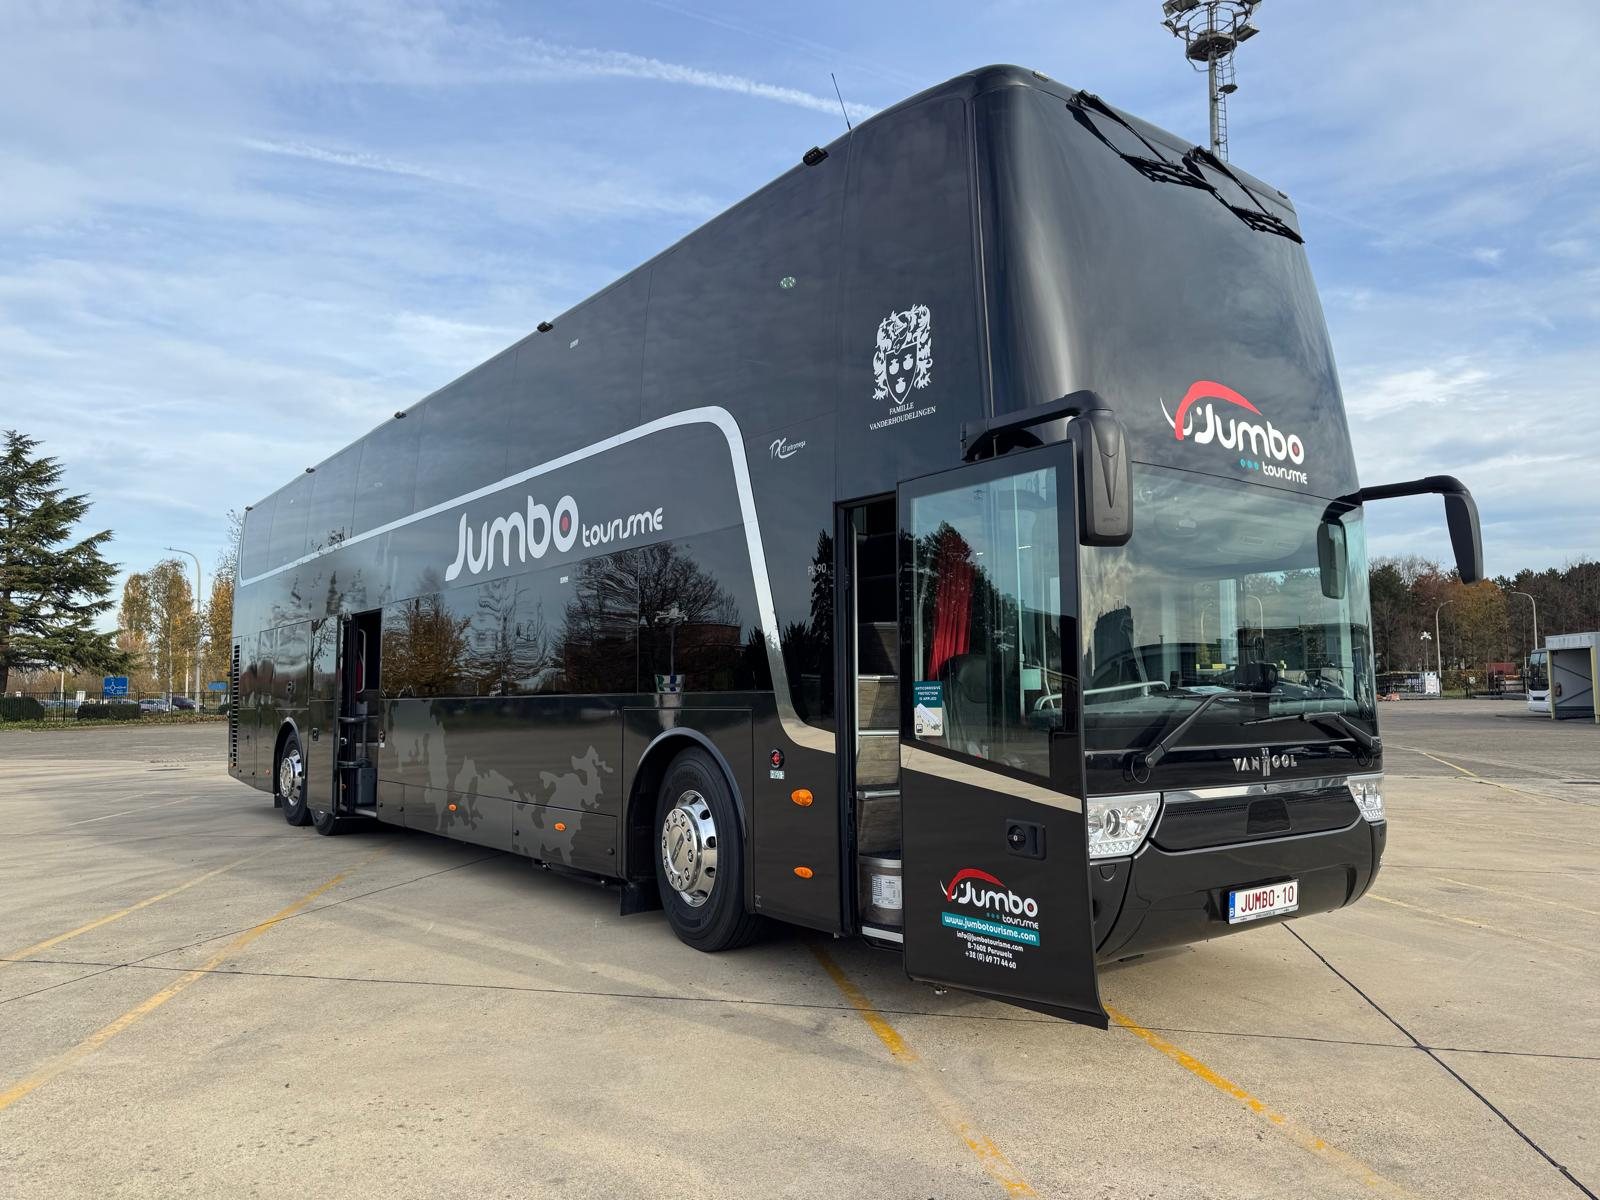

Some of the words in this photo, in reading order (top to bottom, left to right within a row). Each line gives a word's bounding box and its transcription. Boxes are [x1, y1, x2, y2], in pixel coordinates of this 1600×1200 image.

[869, 405, 937, 431] VANDERHOUDELINGEN
[889, 402, 915, 415] FAMILLE
[1194, 402, 1305, 466] Jumbo
[1262, 460, 1309, 486] tourisme
[445, 494, 579, 583] Jumbo
[582, 507, 664, 548] tourisme
[957, 881, 1039, 919] Jumbo
[943, 914, 1037, 942] www.jumbotourisme.com
[1002, 914, 1039, 930] tourisme
[956, 931, 1024, 953] info@jumbotourisme.com
[986, 955, 993, 964] 69
[993, 957, 1001, 966] 77
[1001, 958, 1009, 968] 44
[1008, 960, 1017, 970] 60
